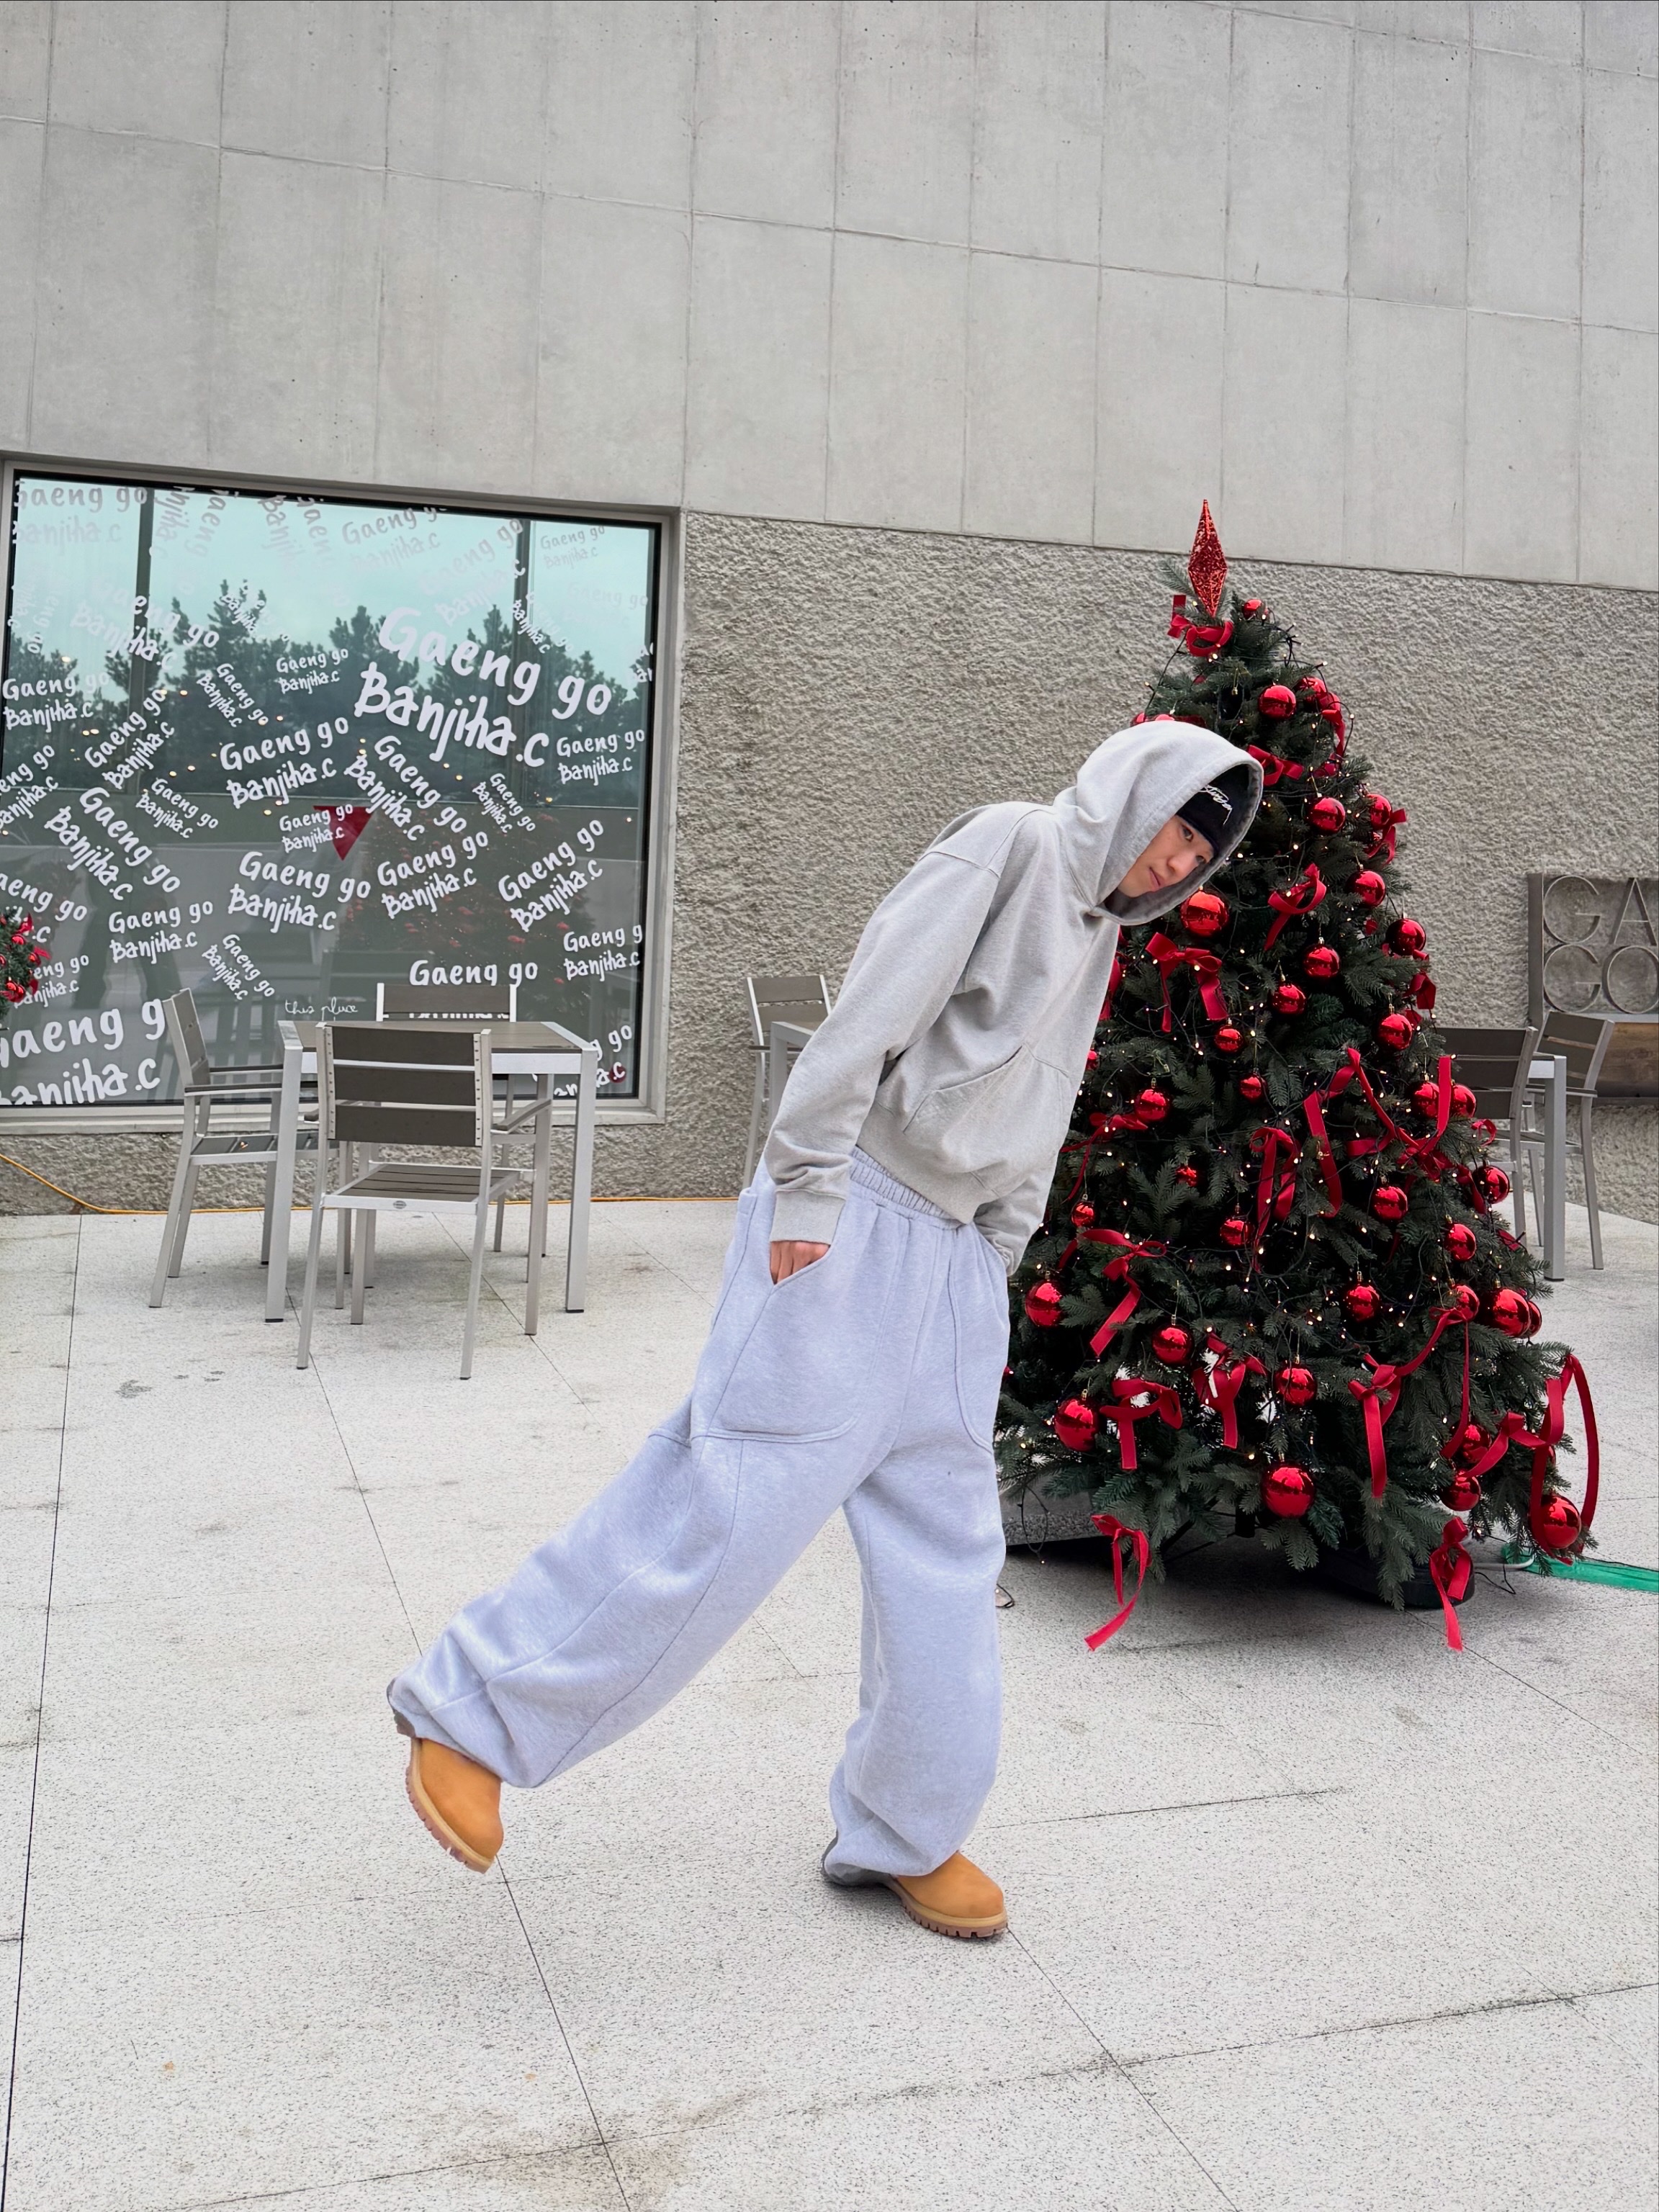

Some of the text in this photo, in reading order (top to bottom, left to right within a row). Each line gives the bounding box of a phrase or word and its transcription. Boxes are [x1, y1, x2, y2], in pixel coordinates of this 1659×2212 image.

[116, 485, 148, 512] go
[342, 507, 417, 546] Gaeng
[496, 518, 523, 548] go
[540, 526, 606, 550] Gaeng go
[183, 624, 220, 647] go
[276, 649, 349, 673] Gaeng go
[278, 670, 340, 694] Banjiha.c
[379, 607, 611, 719] Gaeng go
[3, 672, 111, 701] Gaeng go
[217, 663, 269, 725] Gaeng go
[3, 699, 94, 732] Banjiha.c
[84, 689, 166, 768] Gaeng go
[354, 662, 549, 767] Banjiha.c
[102, 721, 175, 789] Banjiha.c
[220, 717, 349, 770] Gaeng go
[557, 729, 645, 757] Gaeng go
[0, 745, 55, 793] eng go
[226, 757, 337, 809] Banjiha.c
[374, 736, 467, 833] Gaeng go
[557, 755, 634, 786] Banjiha.c
[136, 792, 193, 838] Banjiha.c
[151, 778, 219, 829] Gaeng go
[279, 804, 353, 831] Gaeng go
[343, 754, 426, 842] Banjiha.c
[490, 773, 536, 832] Gaeng go
[44, 806, 133, 900] Banjiha.c
[79, 787, 180, 893] Gaeng go
[282, 827, 345, 853] Banjiha.c
[377, 831, 489, 886] Gaeng go
[498, 819, 604, 902] Gaeng go
[239, 851, 371, 903] Gaeng go
[381, 867, 477, 919] Banjiha.c
[510, 858, 603, 932] Banjiha.c
[55, 899, 88, 922] go
[108, 901, 213, 934] Gaeng go
[228, 883, 337, 933] Banjiha.c
[109, 930, 198, 965] Banjiha.c
[563, 927, 624, 953] Gaeng
[70, 955, 89, 974] go
[202, 944, 248, 1001] Banjiha.c
[222, 934, 275, 997] Gaeng go
[409, 959, 538, 988] Gaeng go
[608, 1025, 632, 1053] go
